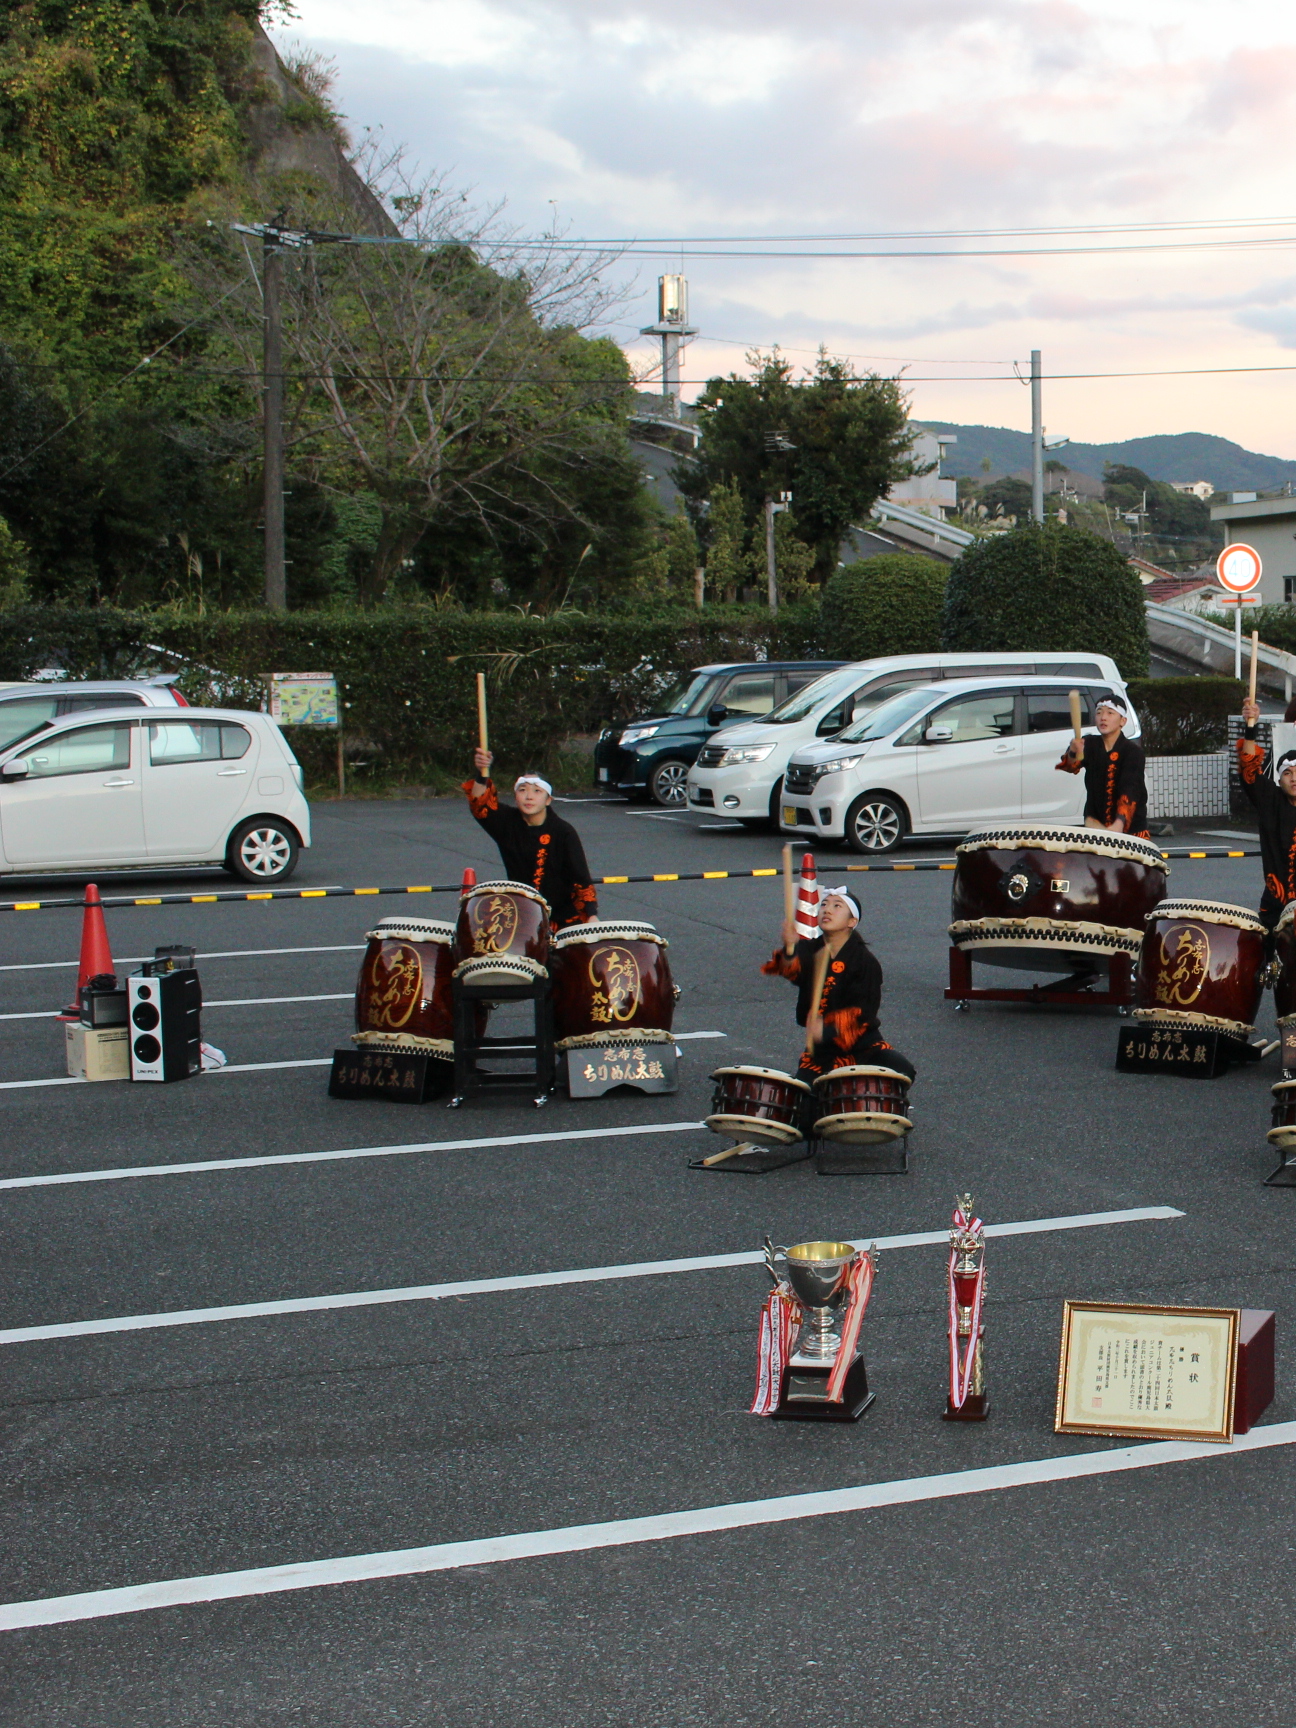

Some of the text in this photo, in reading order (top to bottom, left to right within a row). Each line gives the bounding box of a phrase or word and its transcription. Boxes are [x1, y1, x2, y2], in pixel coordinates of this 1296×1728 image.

[1229, 559, 1251, 577] 40
[604, 1047, 647, 1062] 志布志
[1125, 1041, 1206, 1063] ちりめん太鼓
[584, 1061, 665, 1082] ちりめん太鼓
[1189, 1352, 1200, 1383] 賞状
